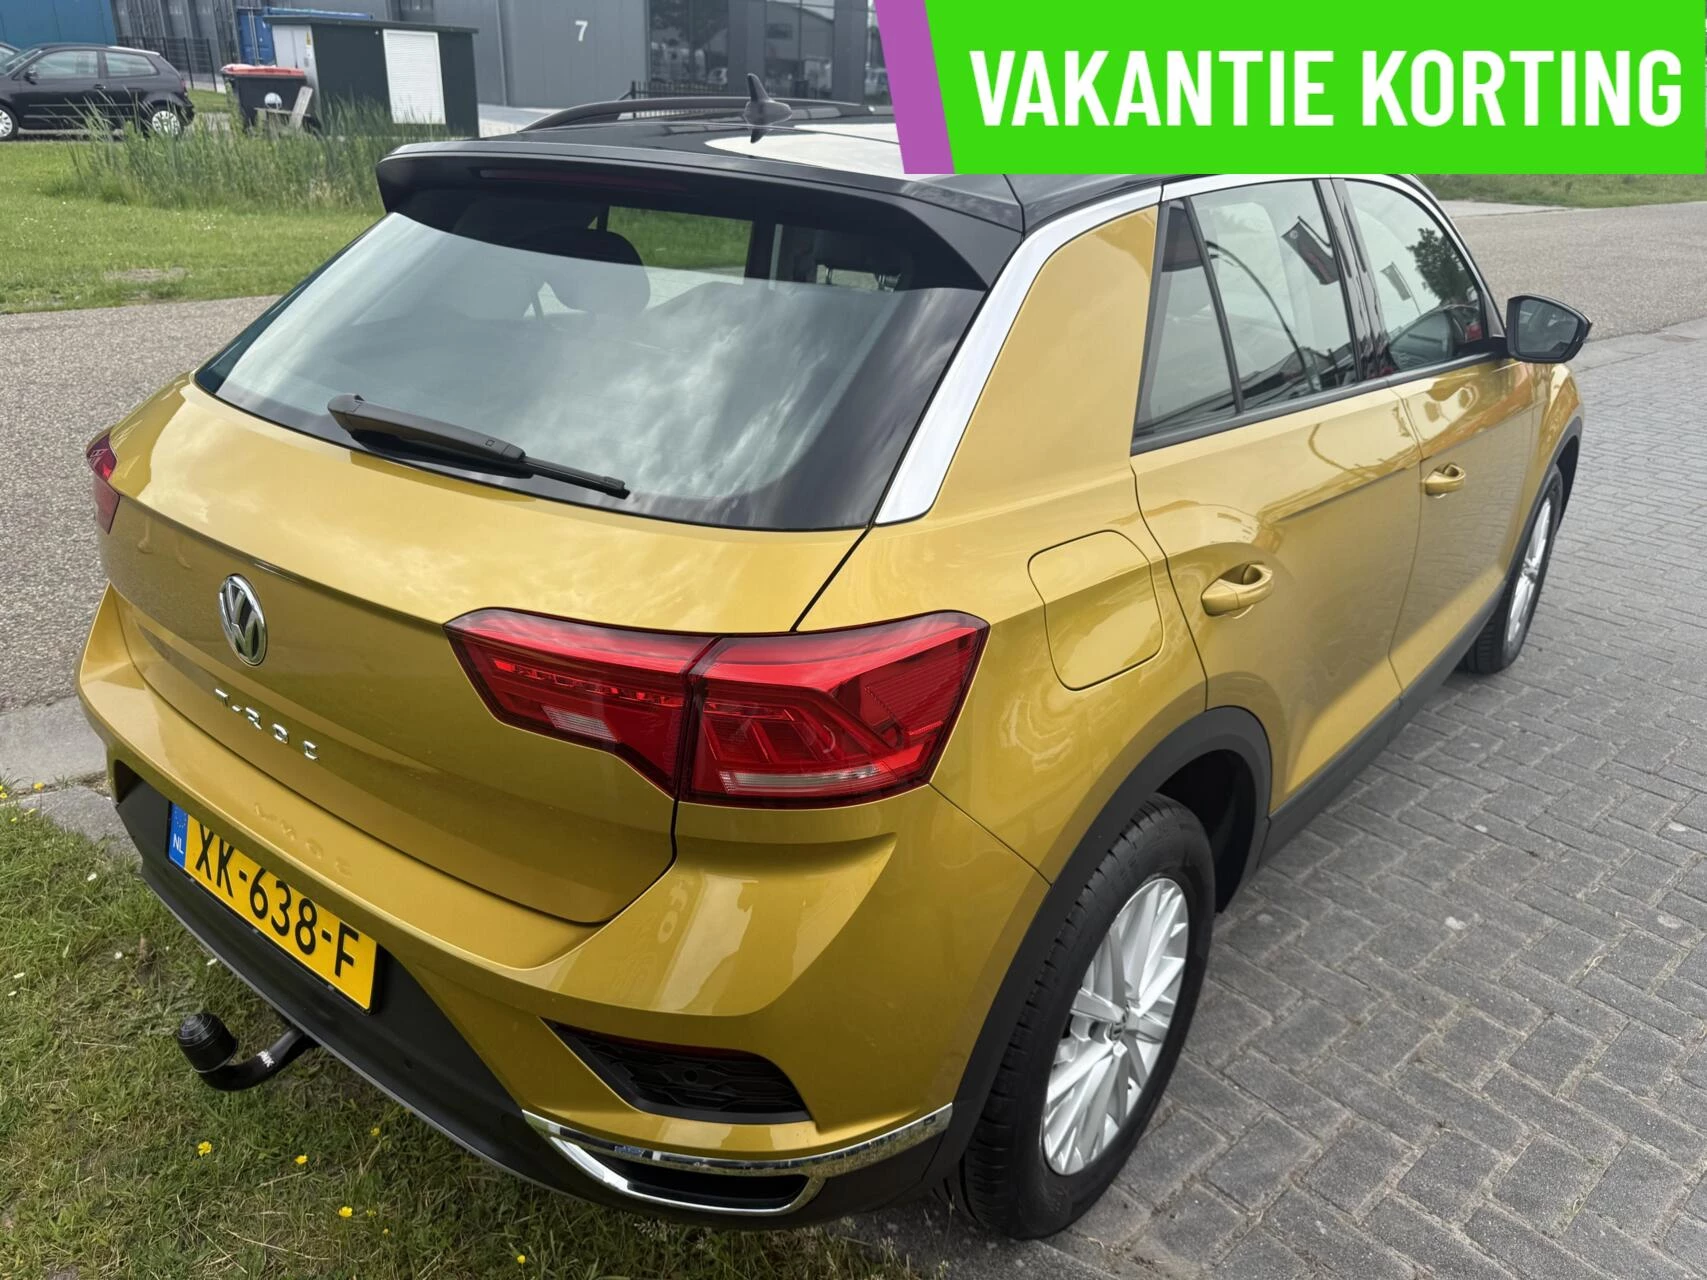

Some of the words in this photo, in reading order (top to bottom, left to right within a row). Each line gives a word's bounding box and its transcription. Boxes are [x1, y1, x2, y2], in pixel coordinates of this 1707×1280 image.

[575, 20, 588, 41] 7
[173, 835, 185, 855] NL
[195, 823, 360, 978] XK-638-F
